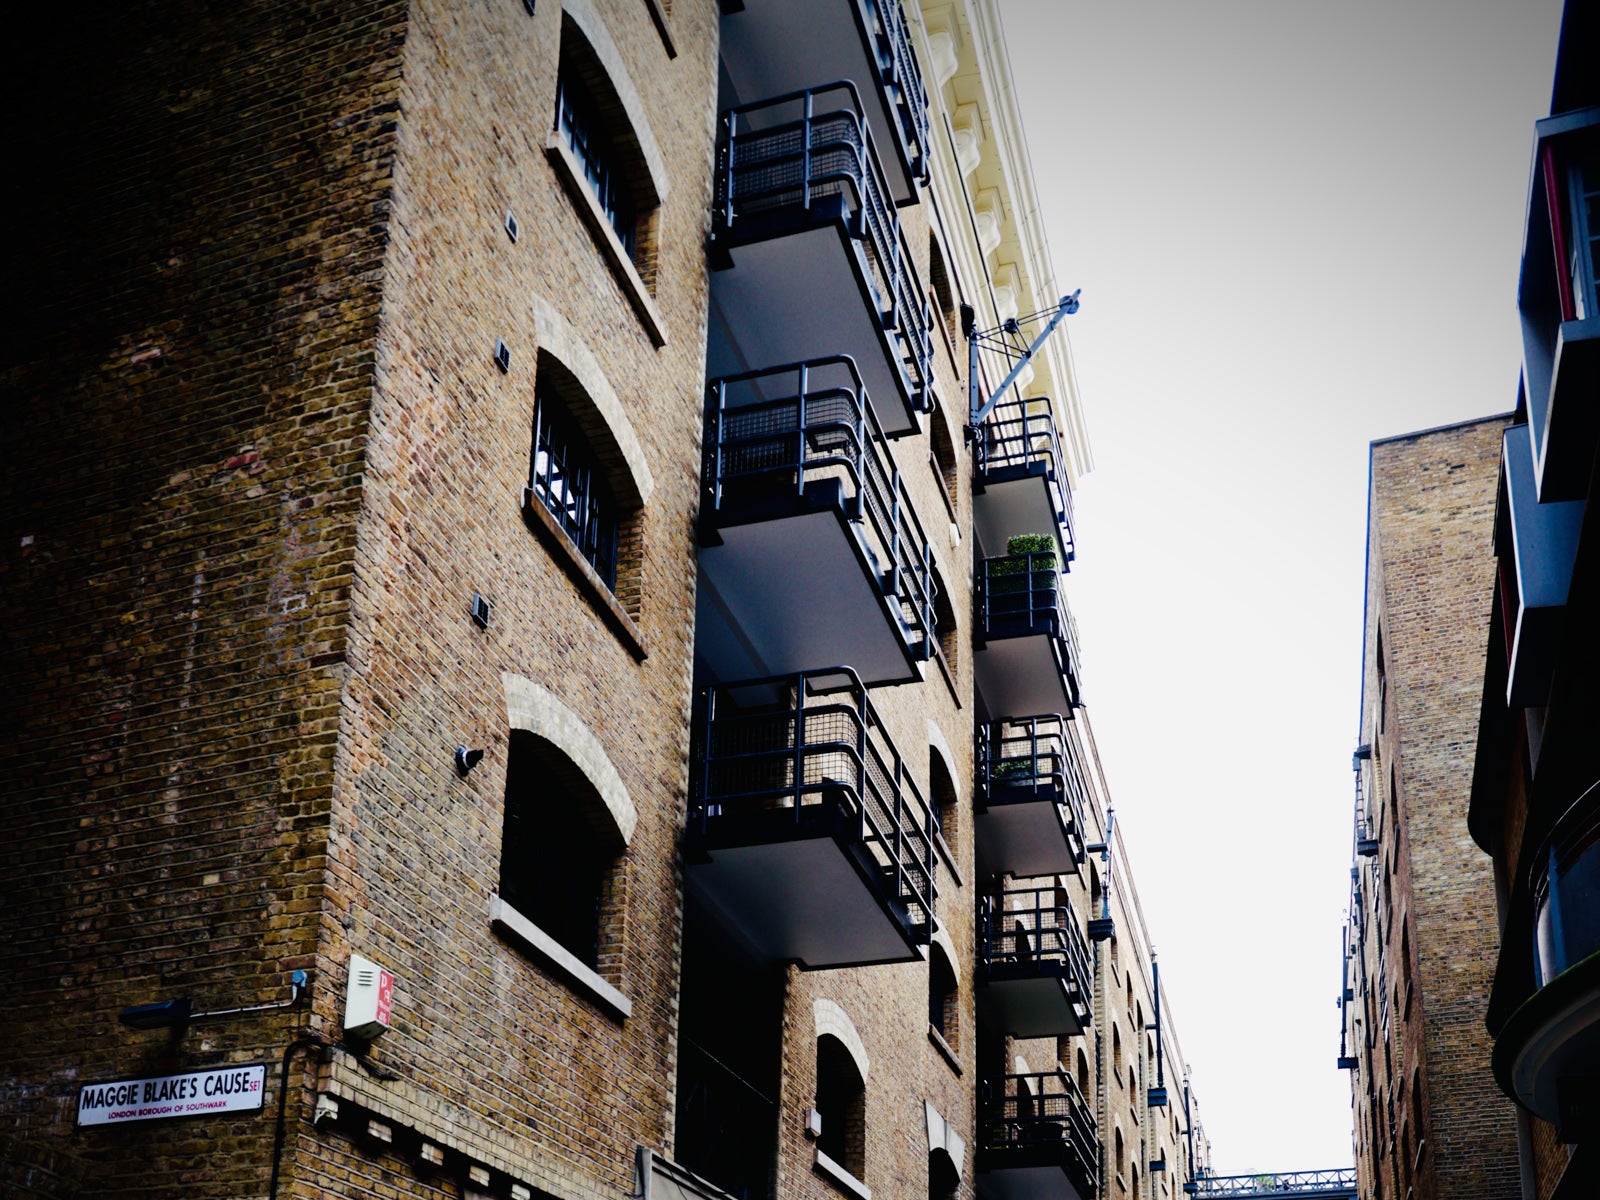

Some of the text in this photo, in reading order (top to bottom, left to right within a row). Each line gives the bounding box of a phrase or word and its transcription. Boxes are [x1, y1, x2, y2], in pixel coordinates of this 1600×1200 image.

[81, 1072, 261, 1110] MAGGIE BLAKE'S CAUSE SE1
[108, 1110, 137, 1120] LONDON
[138, 1107, 172, 1117] BOROUGH
[186, 1101, 227, 1112] SOUTHWARK
